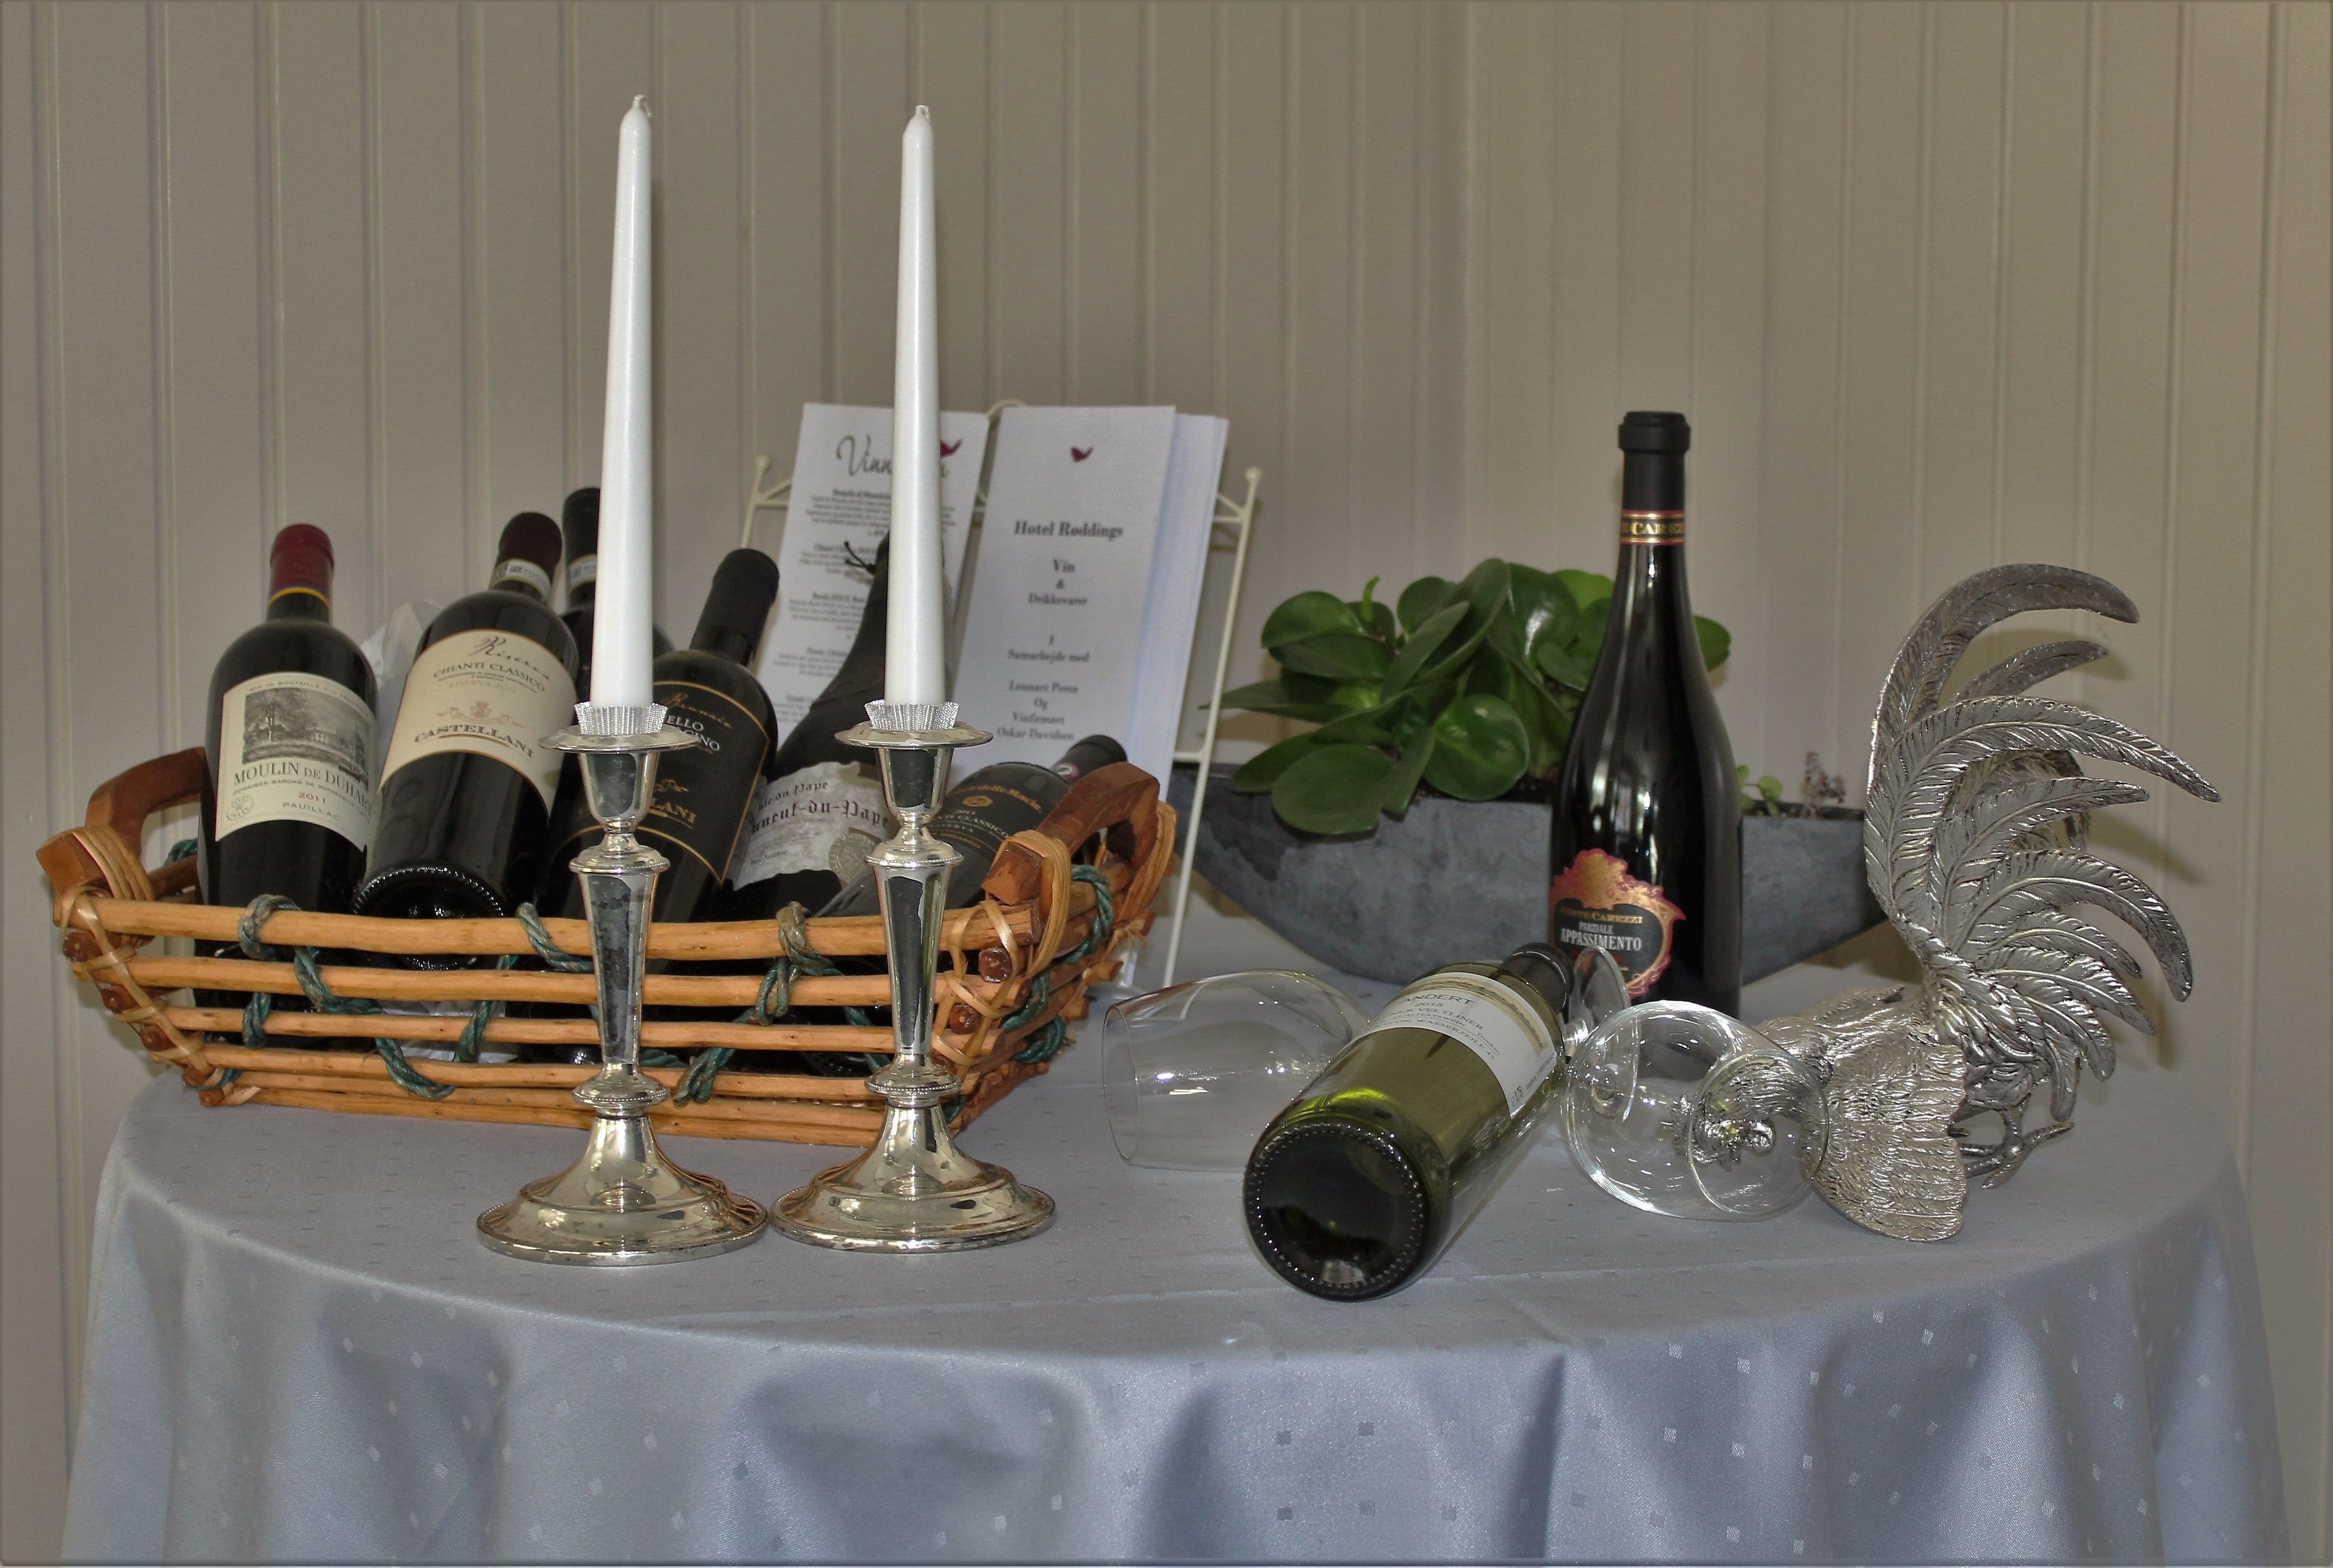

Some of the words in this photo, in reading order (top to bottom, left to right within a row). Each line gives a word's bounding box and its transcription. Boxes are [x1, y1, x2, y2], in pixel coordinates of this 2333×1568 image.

[1014, 519, 1054, 536] Hotel
[1053, 558, 1075, 573] Vin
[433, 662, 485, 677] CHIANTI
[490, 663, 544, 692] CLASSICO
[666, 714, 704, 731] ELLO
[414, 724, 533, 759] CASTELLANI
[234, 762, 300, 786] MOULIN
[304, 767, 321, 780] DE
[298, 792, 326, 804] 2011
[282, 803, 340, 821] PAUILLAC
[1560, 928, 1642, 952] APPASSIMENTO
